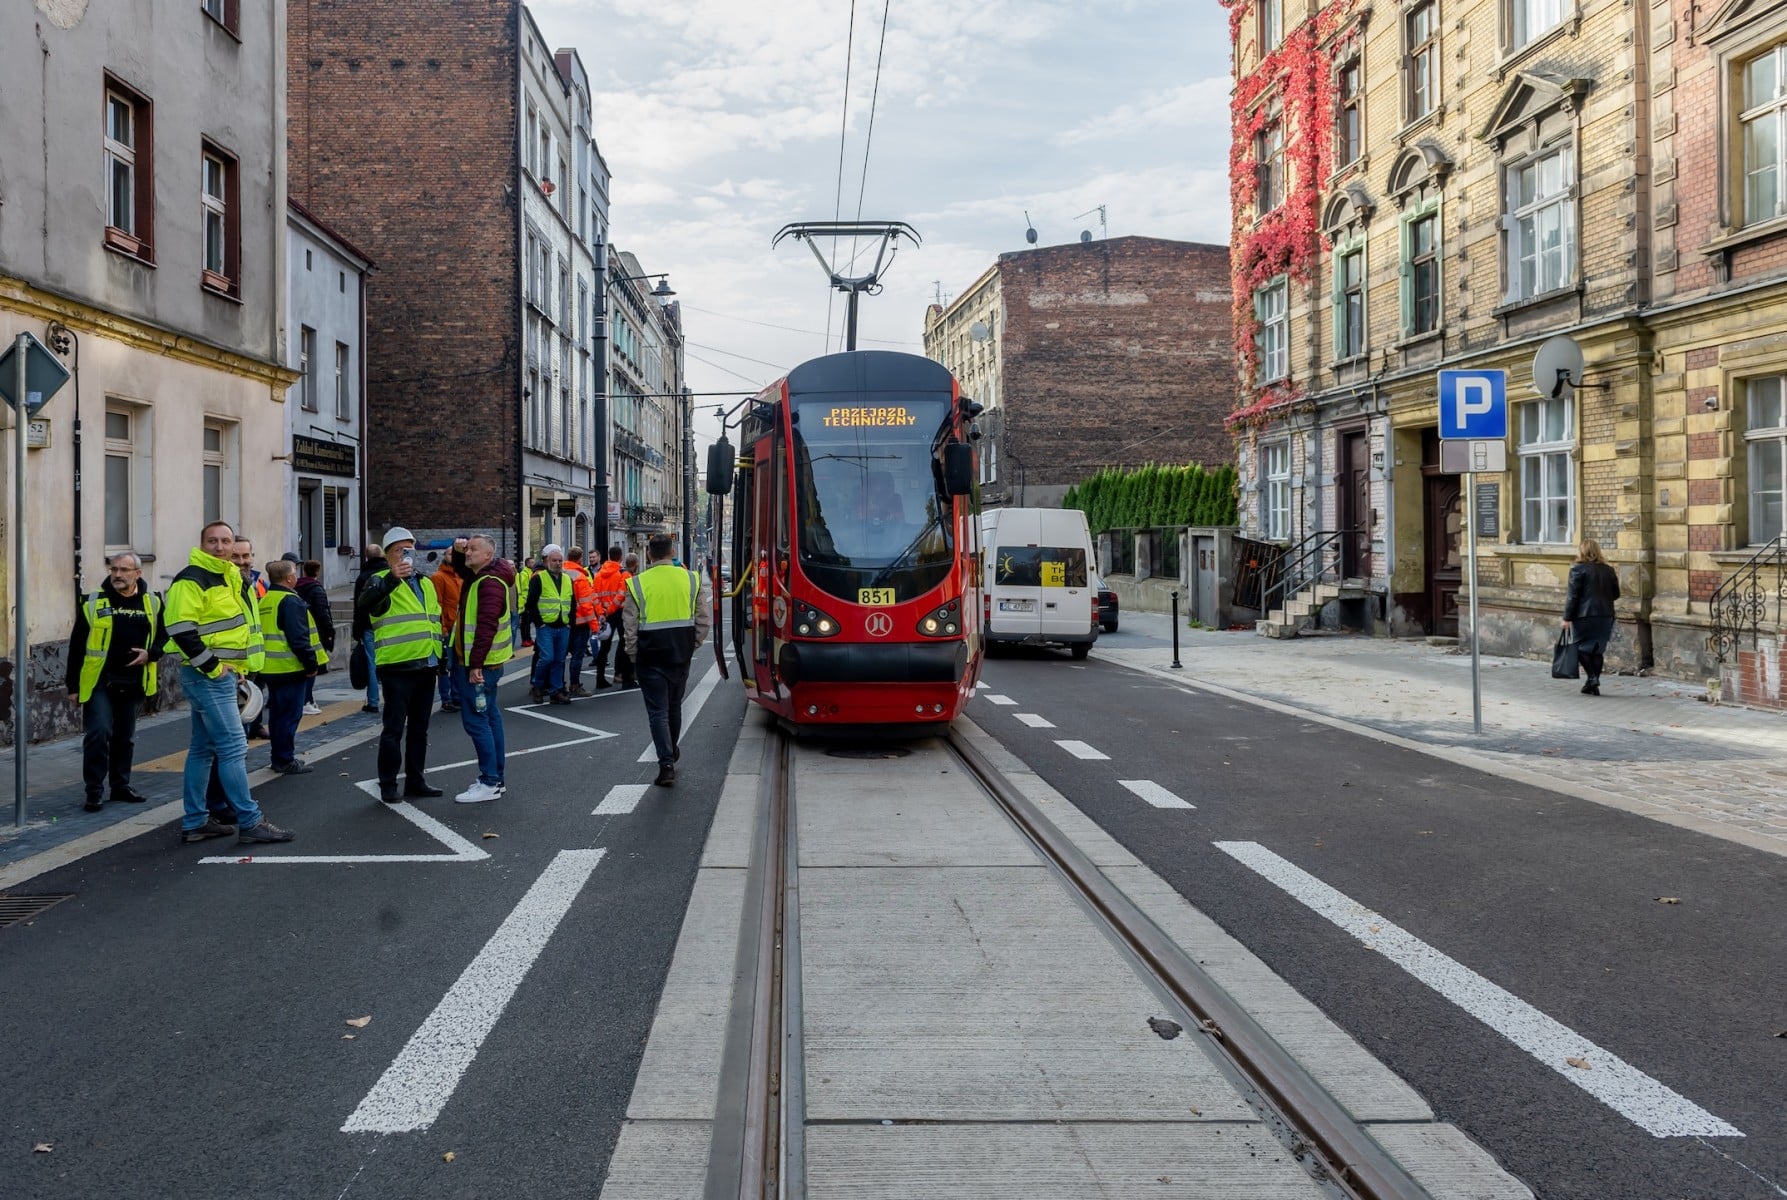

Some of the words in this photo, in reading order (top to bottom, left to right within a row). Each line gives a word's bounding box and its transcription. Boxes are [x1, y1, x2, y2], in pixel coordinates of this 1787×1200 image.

[1455, 377, 1492, 430] P
[831, 407, 906, 417] PRZEJAZD
[823, 416, 916, 427] TECHNICZNY
[30, 424, 43, 433] 52
[862, 591, 890, 604] 851
